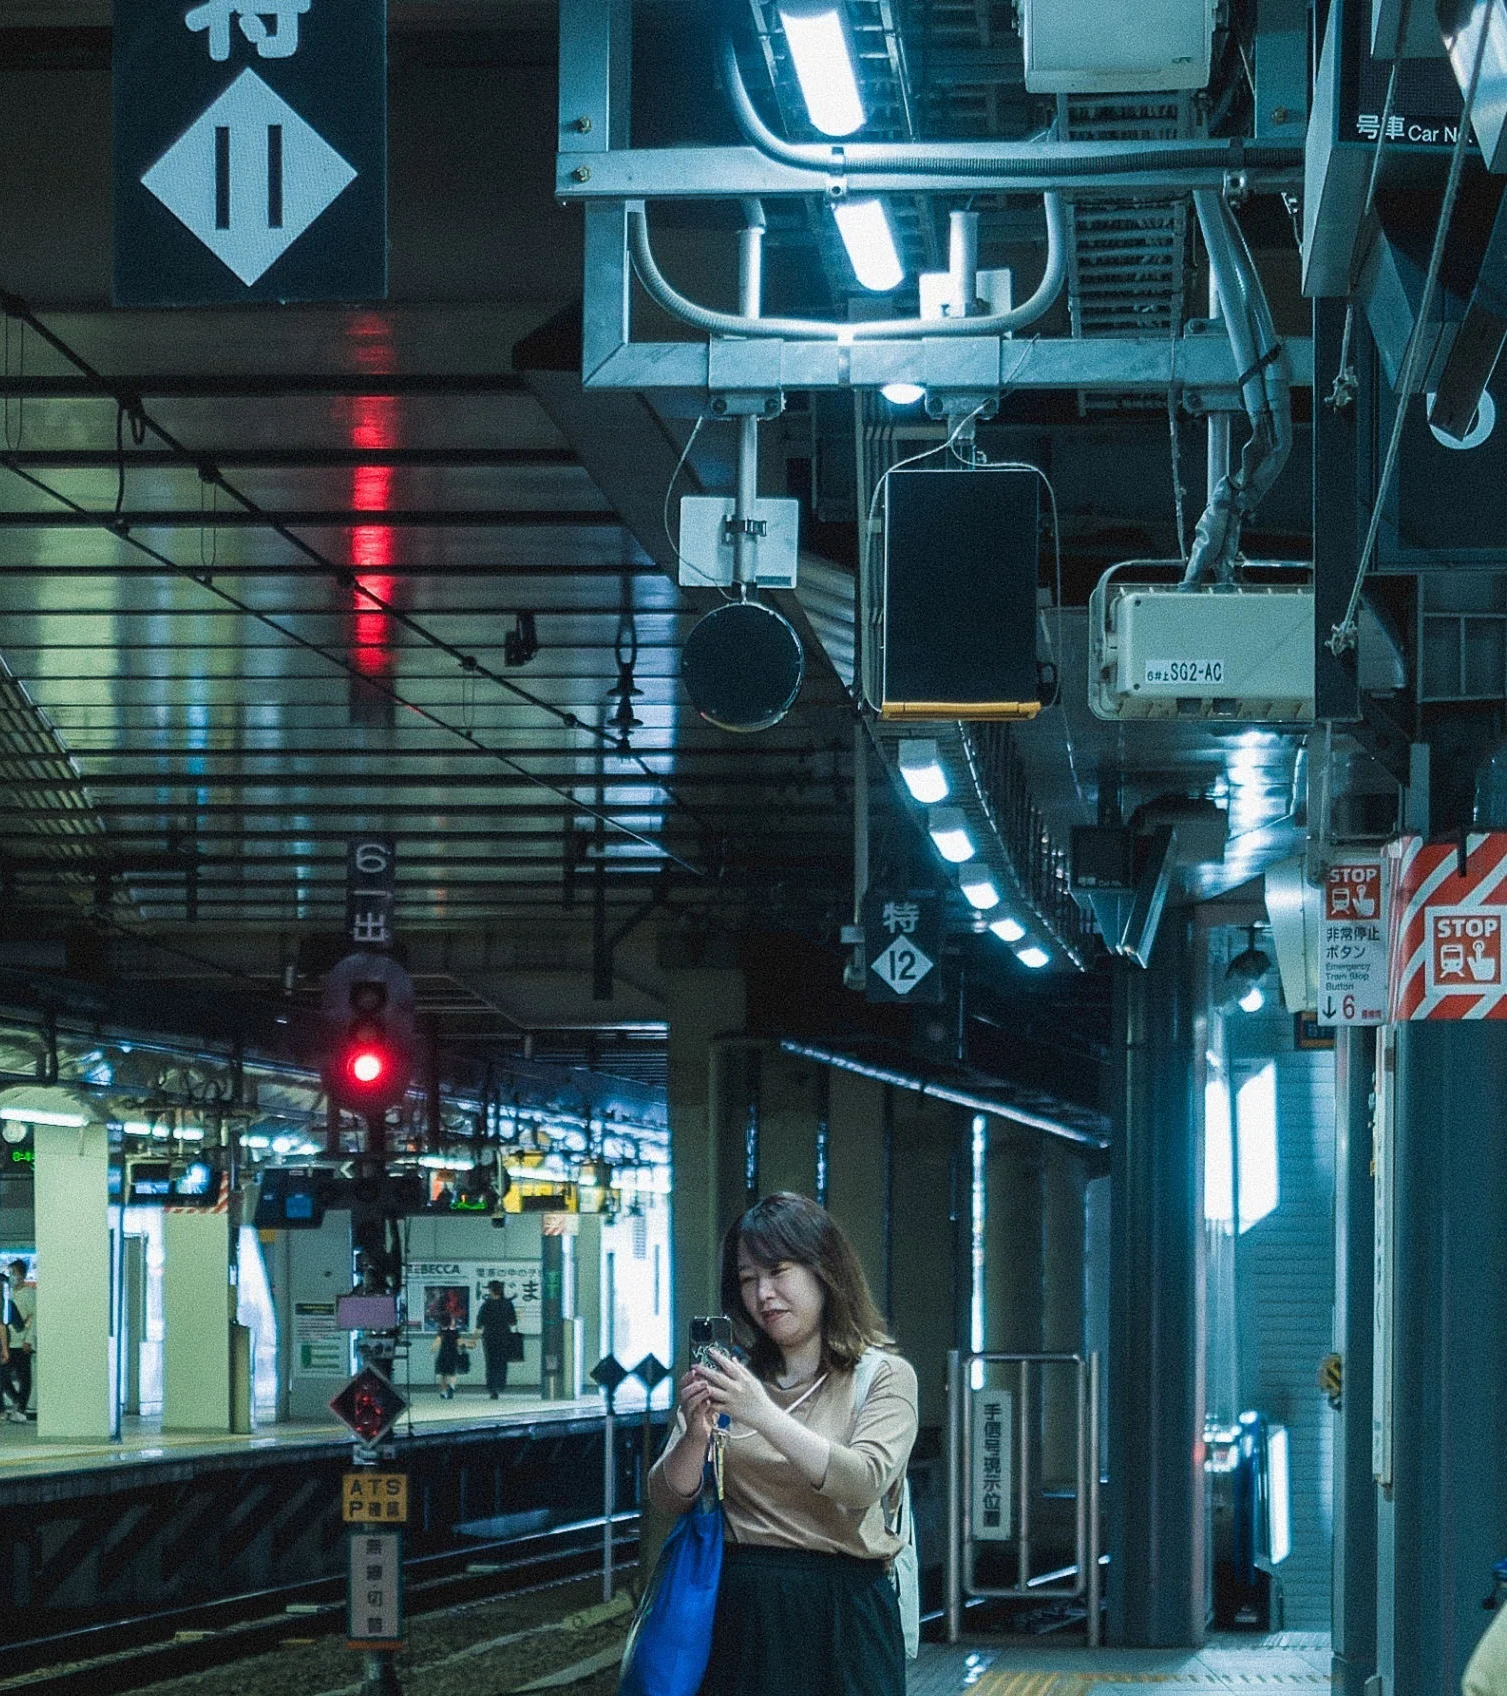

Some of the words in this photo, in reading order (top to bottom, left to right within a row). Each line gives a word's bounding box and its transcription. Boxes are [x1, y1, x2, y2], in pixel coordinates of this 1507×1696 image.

[1357, 114, 1406, 140] 号車
[1408, 124, 1440, 143] Car
[214, 124, 283, 230] 11
[1330, 868, 1377, 883] STOP
[882, 902, 920, 934] 特
[1326, 926, 1381, 942] 非常停止
[1437, 919, 1499, 938] STOP
[1326, 945, 1366, 960] ボタン
[889, 950, 917, 981] 12
[1326, 963, 1371, 972] Emergency
[1326, 972, 1348, 981] Train
[1350, 972, 1370, 982] Stop
[1326, 982, 1354, 991] Button
[1342, 994, 1356, 1020] 6
[350, 1478, 402, 1496] ATS
